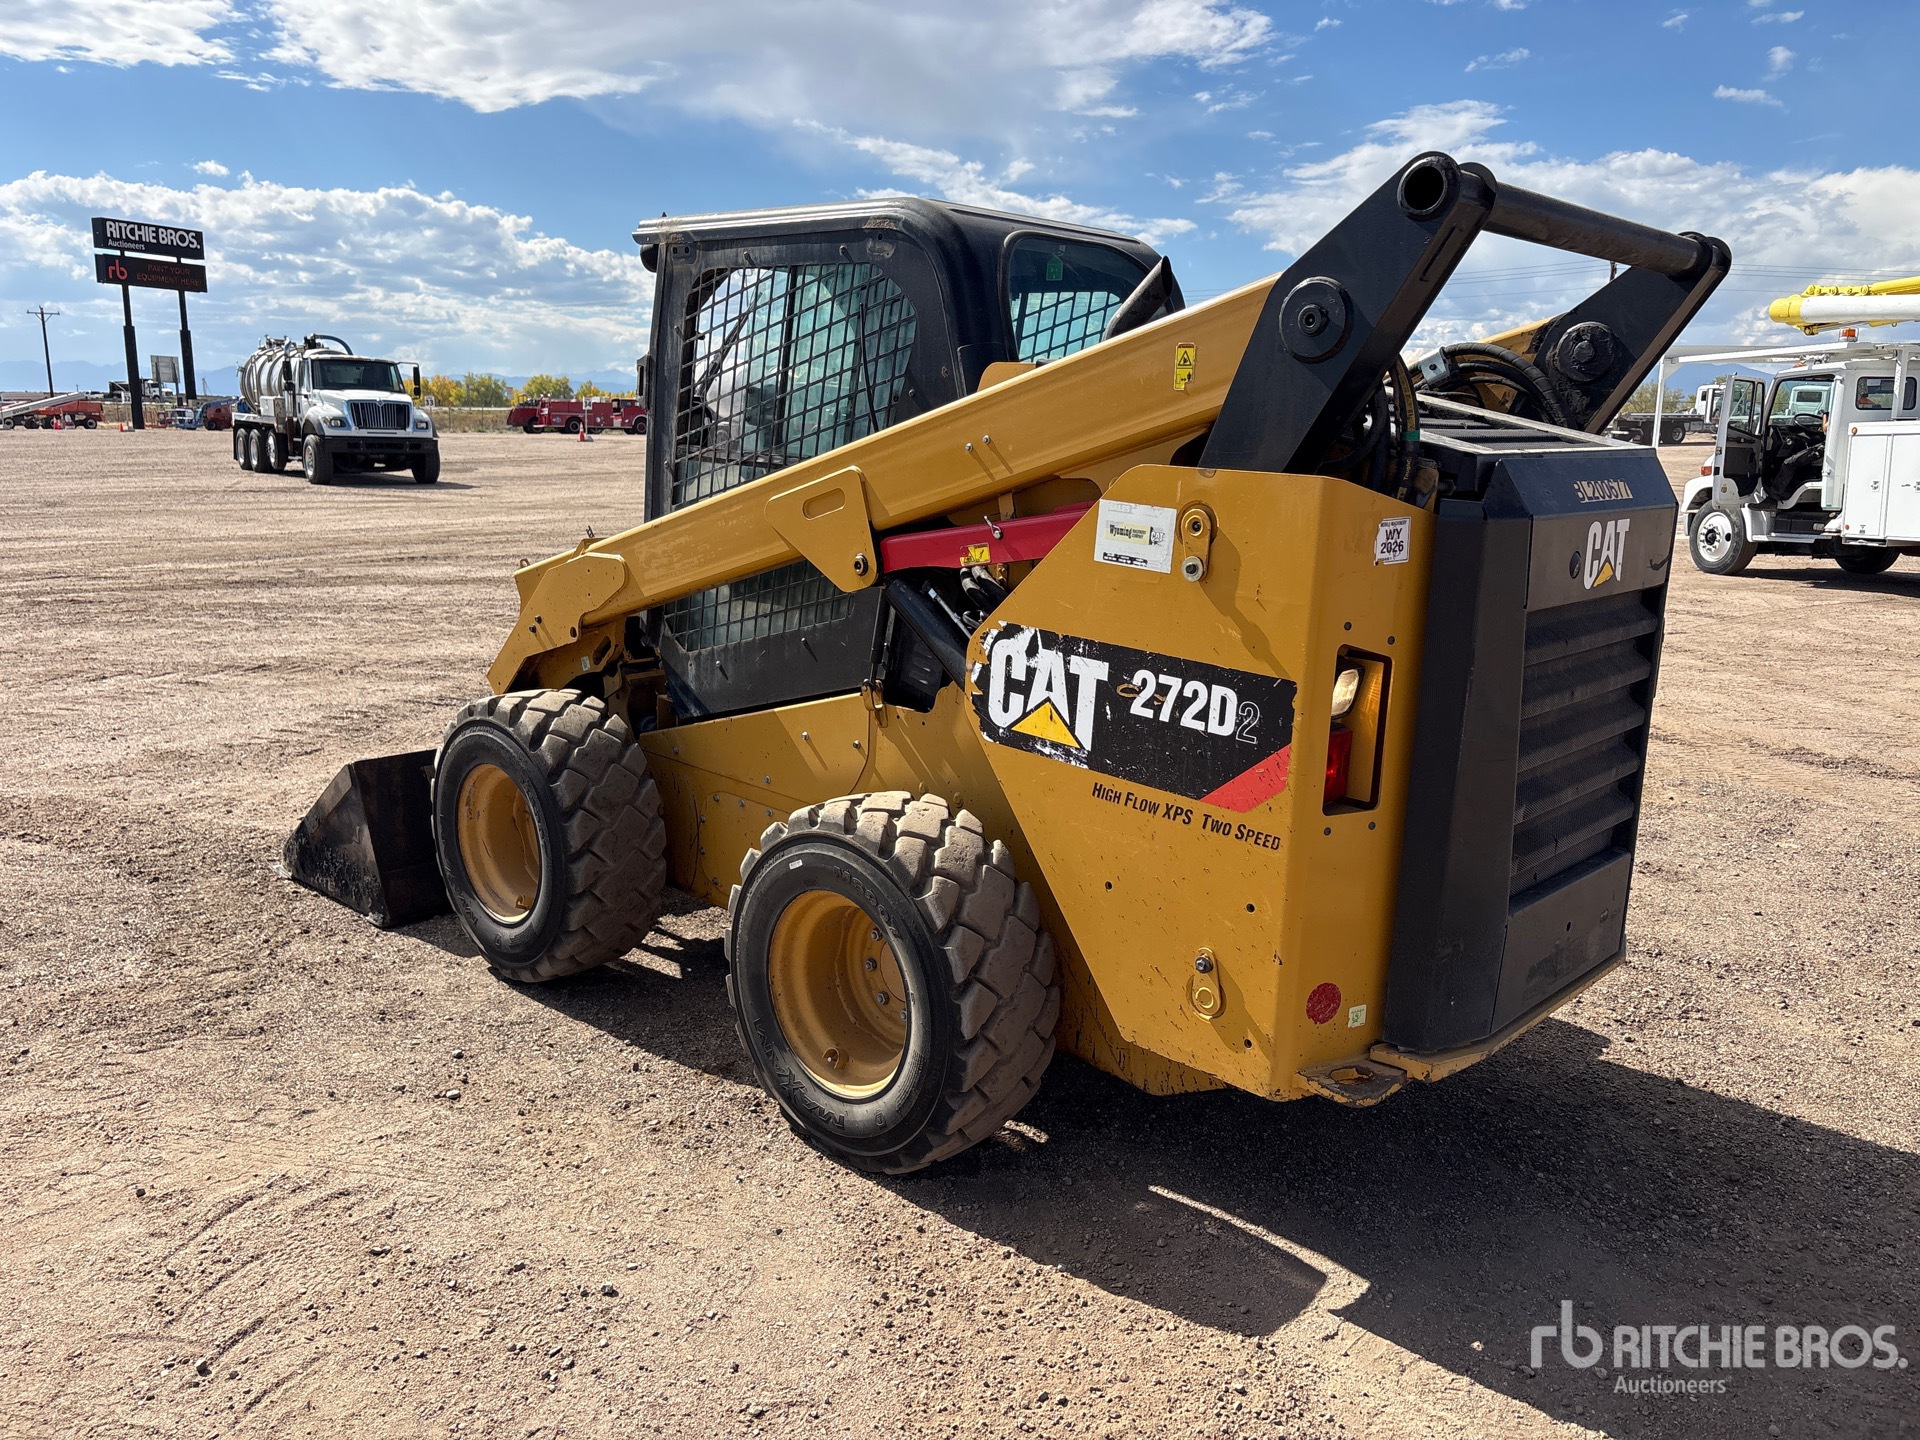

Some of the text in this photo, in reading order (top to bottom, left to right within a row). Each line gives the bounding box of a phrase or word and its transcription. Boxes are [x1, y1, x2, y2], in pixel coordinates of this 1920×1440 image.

[106, 220, 201, 249] RITCHIE BROS.
[108, 238, 146, 251] Auctioneers
[107, 259, 128, 281] rb
[1109, 524, 1132, 539] Wyoming
[1150, 531, 1164, 542] CAT
[1385, 528, 1402, 541] WY
[1380, 540, 1404, 554] 2026
[1583, 518, 1630, 590] CAT
[988, 636, 1109, 751] CAT
[1161, 802, 1194, 826] XPS
